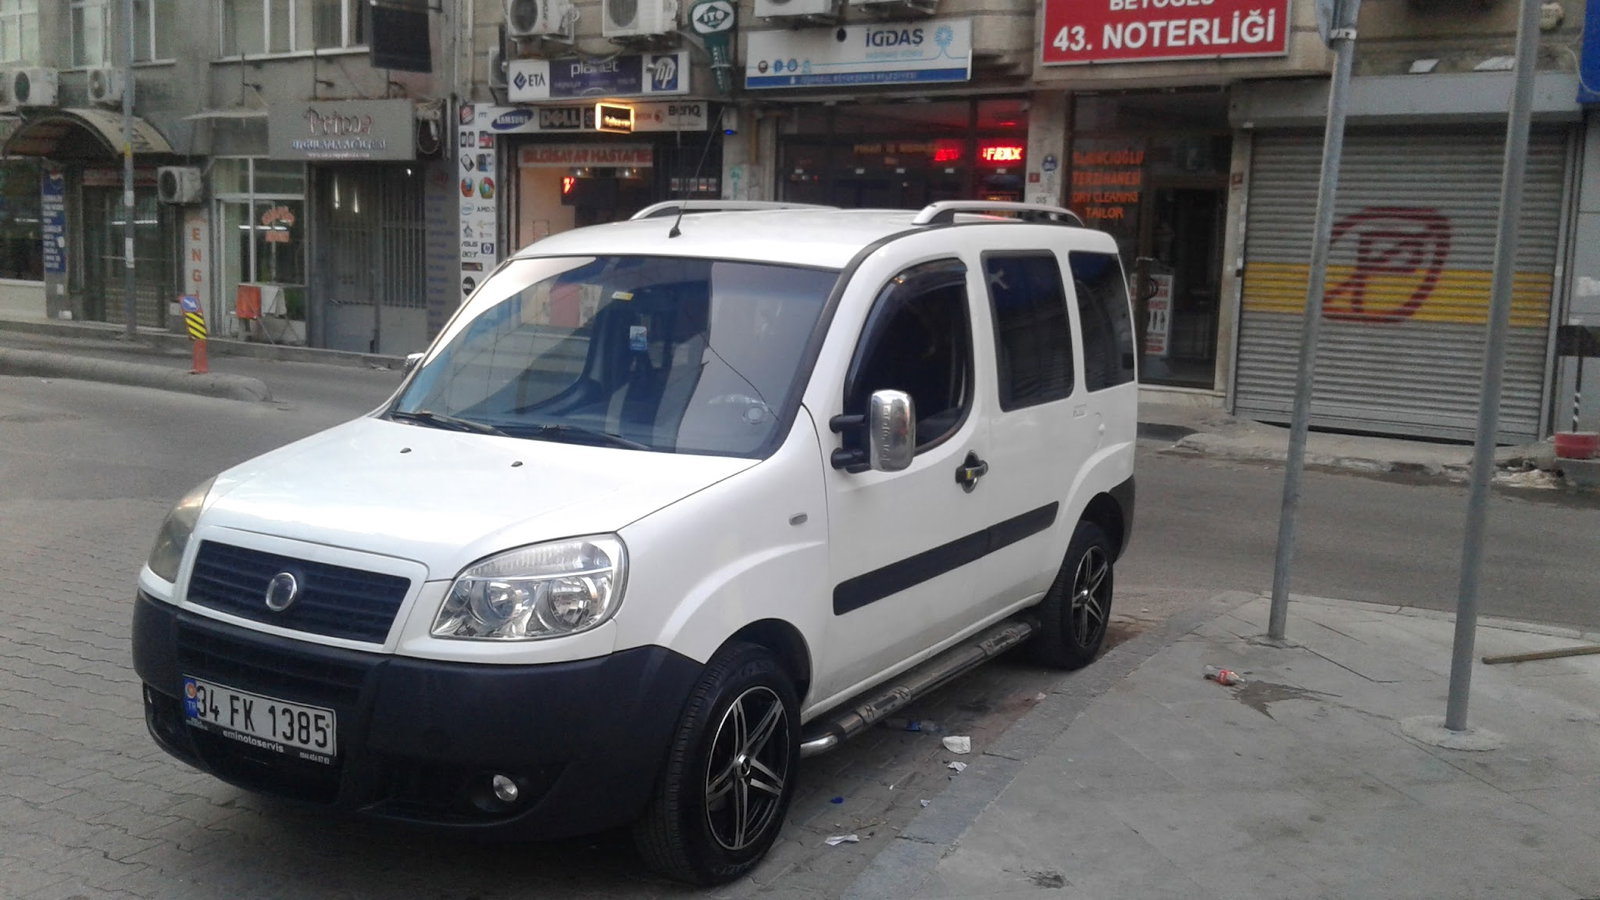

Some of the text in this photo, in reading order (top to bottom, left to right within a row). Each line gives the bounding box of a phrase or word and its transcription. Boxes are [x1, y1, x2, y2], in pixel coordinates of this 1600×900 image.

[1053, 9, 1276, 51] 43. NOTERLİĞİ
[196, 685, 220, 722] 34
[229, 695, 256, 733] FK
[268, 705, 328, 748] 1385
